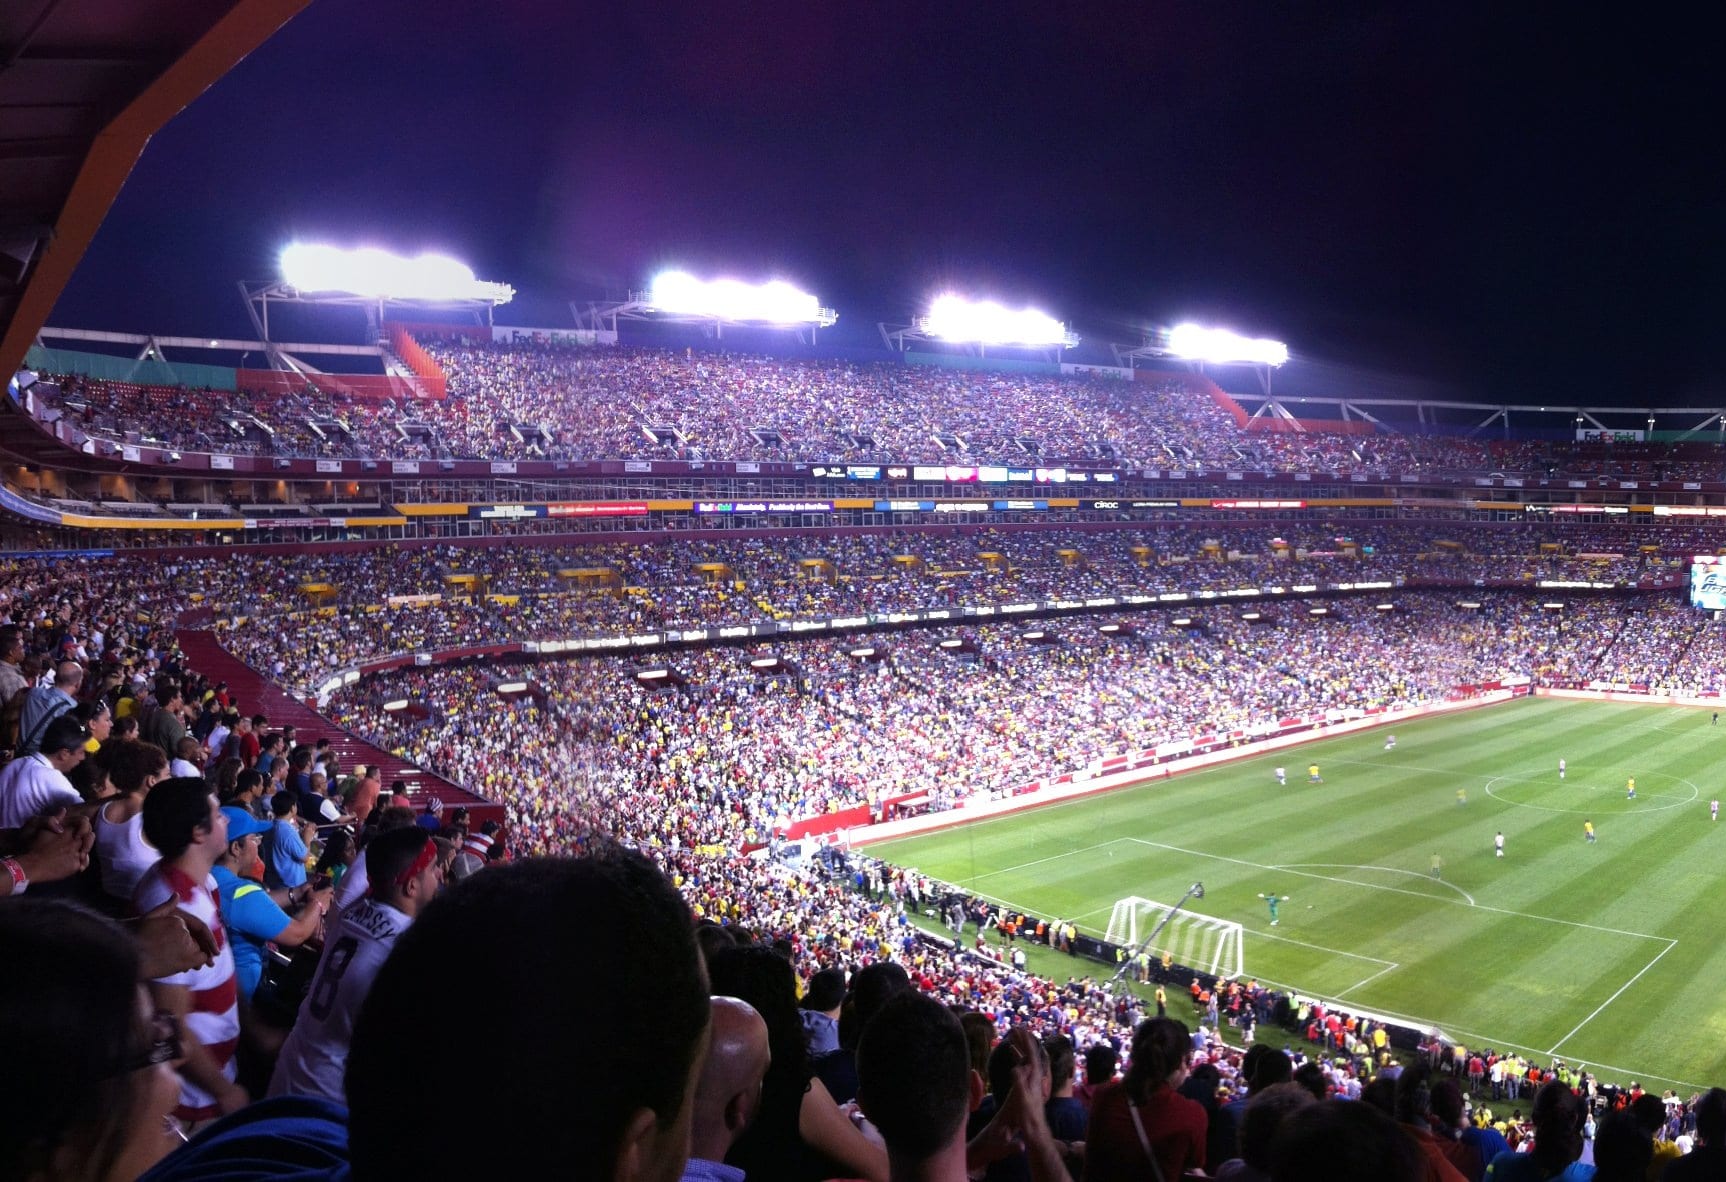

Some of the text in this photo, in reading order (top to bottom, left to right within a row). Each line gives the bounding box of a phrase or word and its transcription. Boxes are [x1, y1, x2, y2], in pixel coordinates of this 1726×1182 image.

[1584, 431, 1636, 441] FedExField
[344, 905, 396, 940] EMPSEY
[310, 936, 358, 1021] 8
